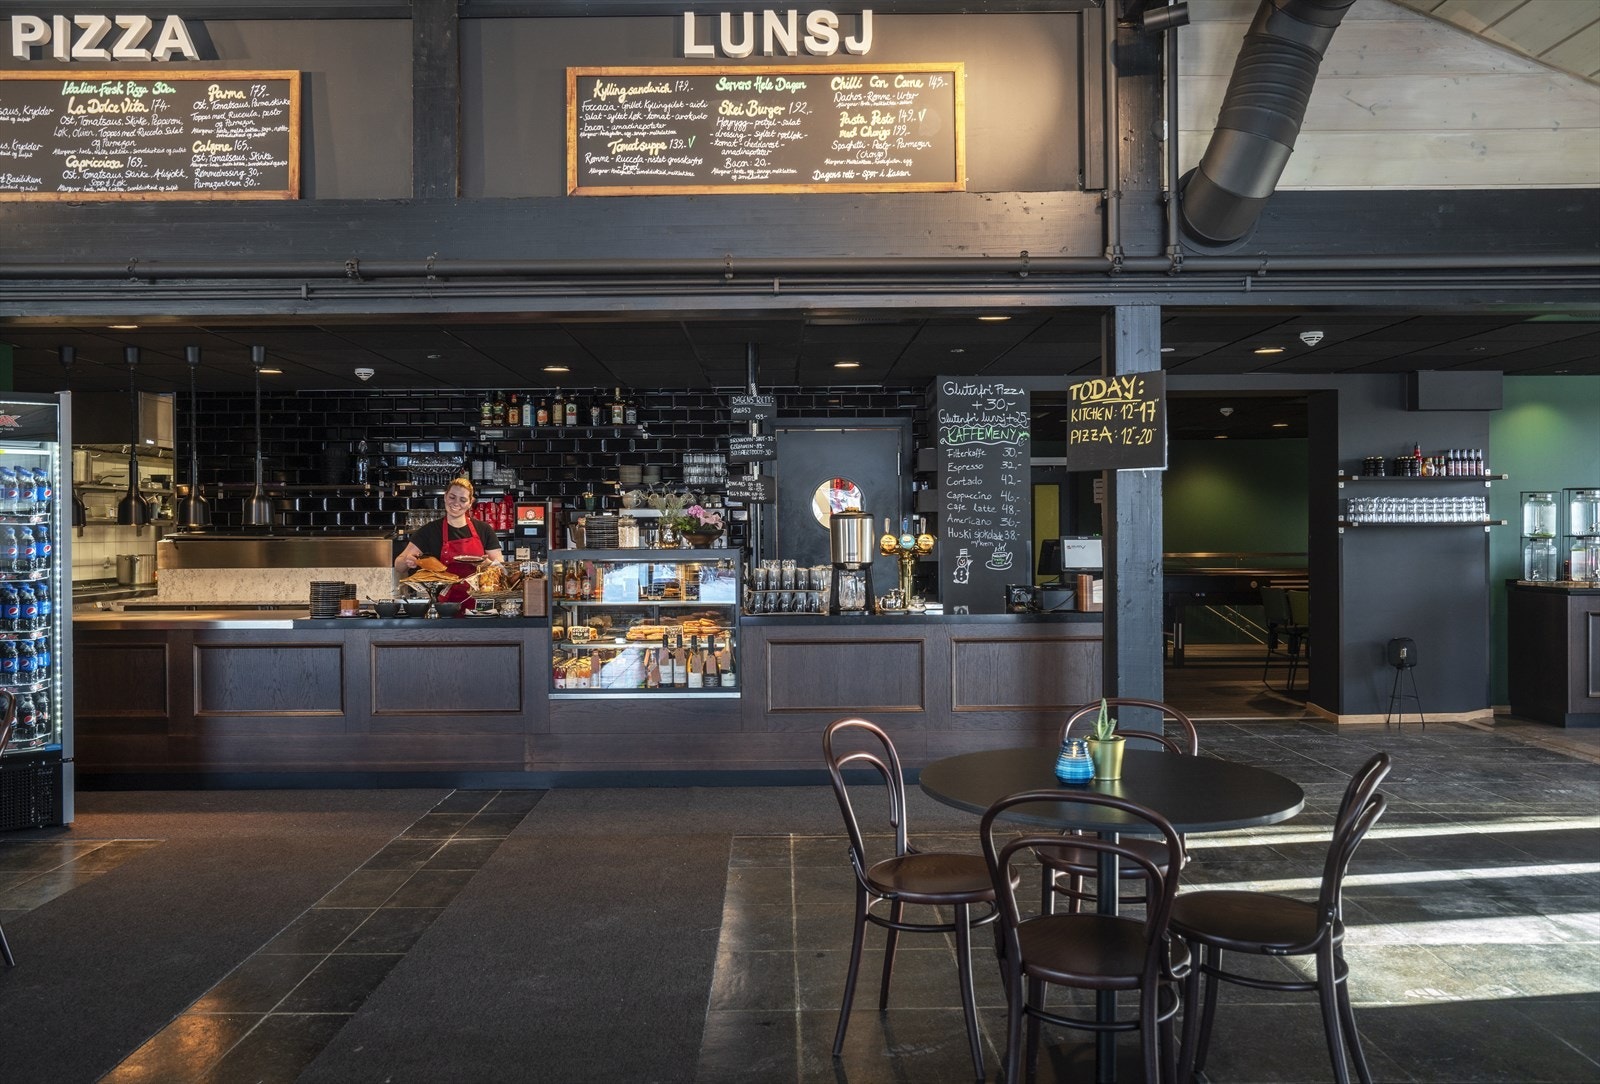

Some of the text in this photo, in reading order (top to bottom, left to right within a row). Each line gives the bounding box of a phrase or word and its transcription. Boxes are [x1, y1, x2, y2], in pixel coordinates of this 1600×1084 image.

[12, 15, 200, 62] PIZZA
[684, 9, 873, 58] LUNSJ
[593, 79, 672, 103] Kyllingsandwich
[775, 77, 807, 94] Dagen
[830, 76, 863, 91] Chilli
[869, 75, 889, 89] Con
[208, 84, 246, 102] Parma
[67, 96, 86, 114] La
[87, 99, 120, 114] Dolce
[121, 98, 149, 113] Vita
[718, 99, 745, 116] Skei
[745, 100, 786, 119] Burger
[839, 111, 867, 128] Pasta
[121, 129, 136, 137] med
[607, 138, 668, 155] Tomatsuppe
[65, 155, 124, 172] Capricciosa
[942, 381, 993, 399] Glutenfri
[1069, 375, 1145, 401] TODAY:
[938, 408, 979, 424] Glutenfri
[947, 426, 1016, 443] KAFFEMENY
[1070, 425, 1118, 445] PIZZA:
[947, 462, 984, 474] Espresso
[946, 474, 1022, 486] Cortado 42,-
[946, 491, 992, 503] Cappuccino
[973, 503, 997, 513] latte
[946, 513, 992, 526] Americano
[947, 527, 972, 539] Huski
